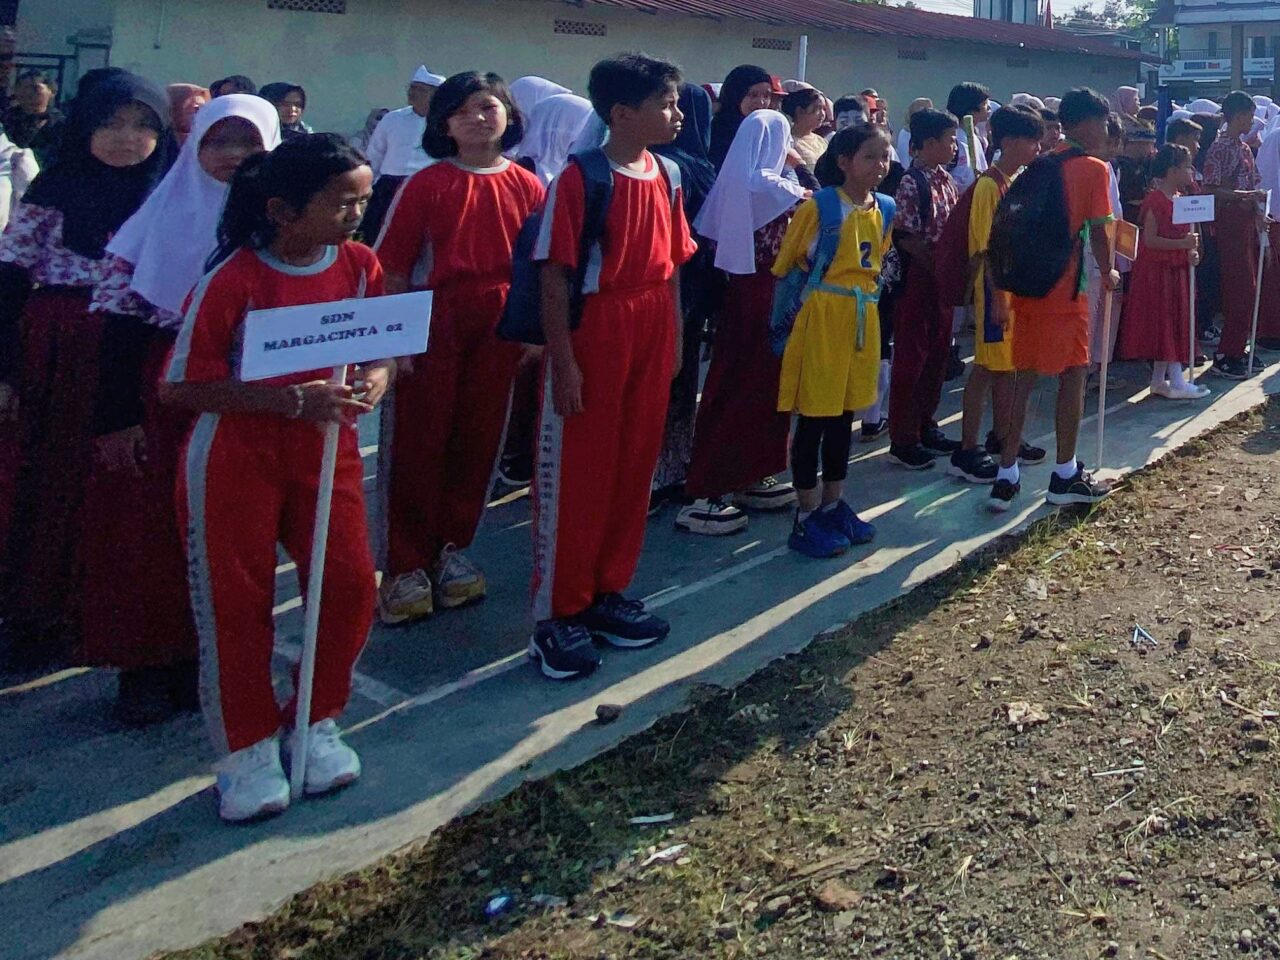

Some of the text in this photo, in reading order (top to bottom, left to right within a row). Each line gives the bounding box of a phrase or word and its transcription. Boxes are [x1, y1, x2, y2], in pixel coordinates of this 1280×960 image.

[860, 241, 873, 268] 2
[319, 311, 356, 326] SDN
[263, 326, 379, 352] MARGACINTA
